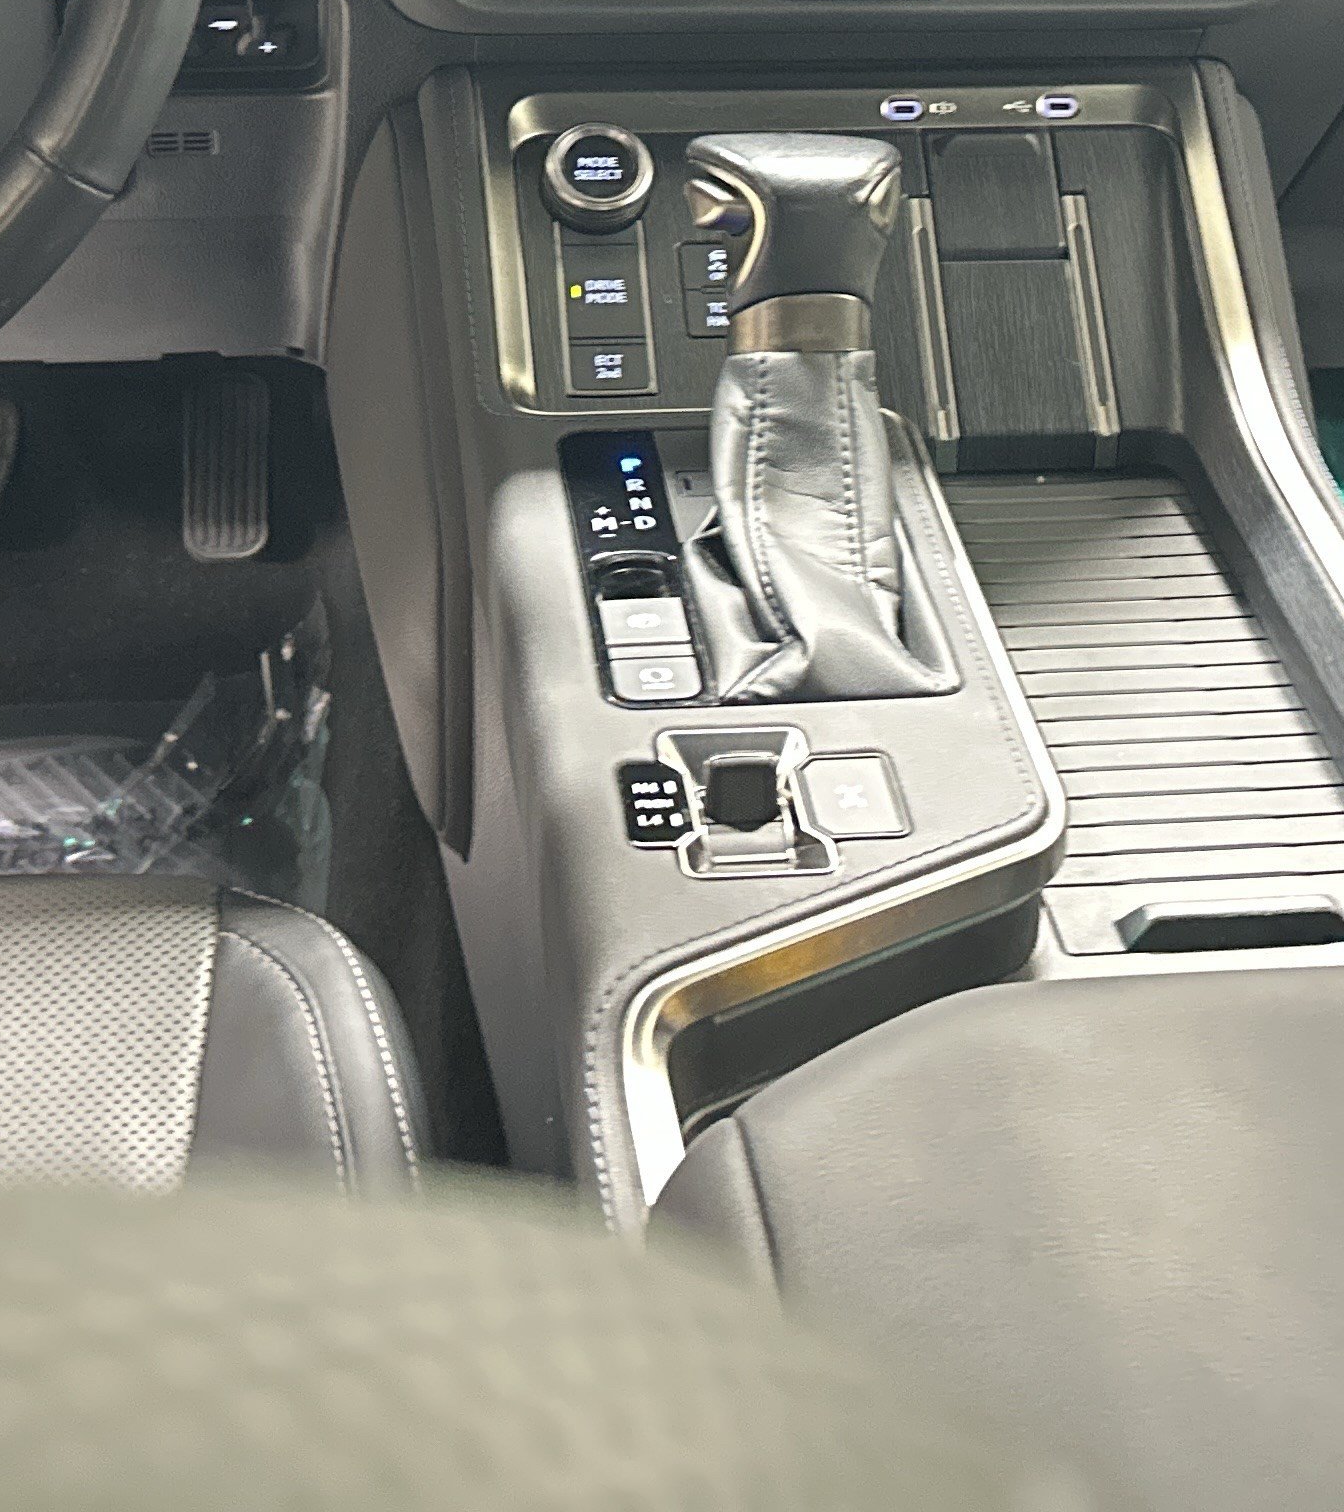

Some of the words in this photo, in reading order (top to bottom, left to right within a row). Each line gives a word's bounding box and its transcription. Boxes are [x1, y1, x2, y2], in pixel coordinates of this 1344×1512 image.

[576, 156, 619, 168] MODE
[584, 291, 629, 304] MODE
[620, 457, 642, 473] P
[625, 478, 647, 492] R
[629, 496, 653, 511] N
[633, 515, 657, 530] D
